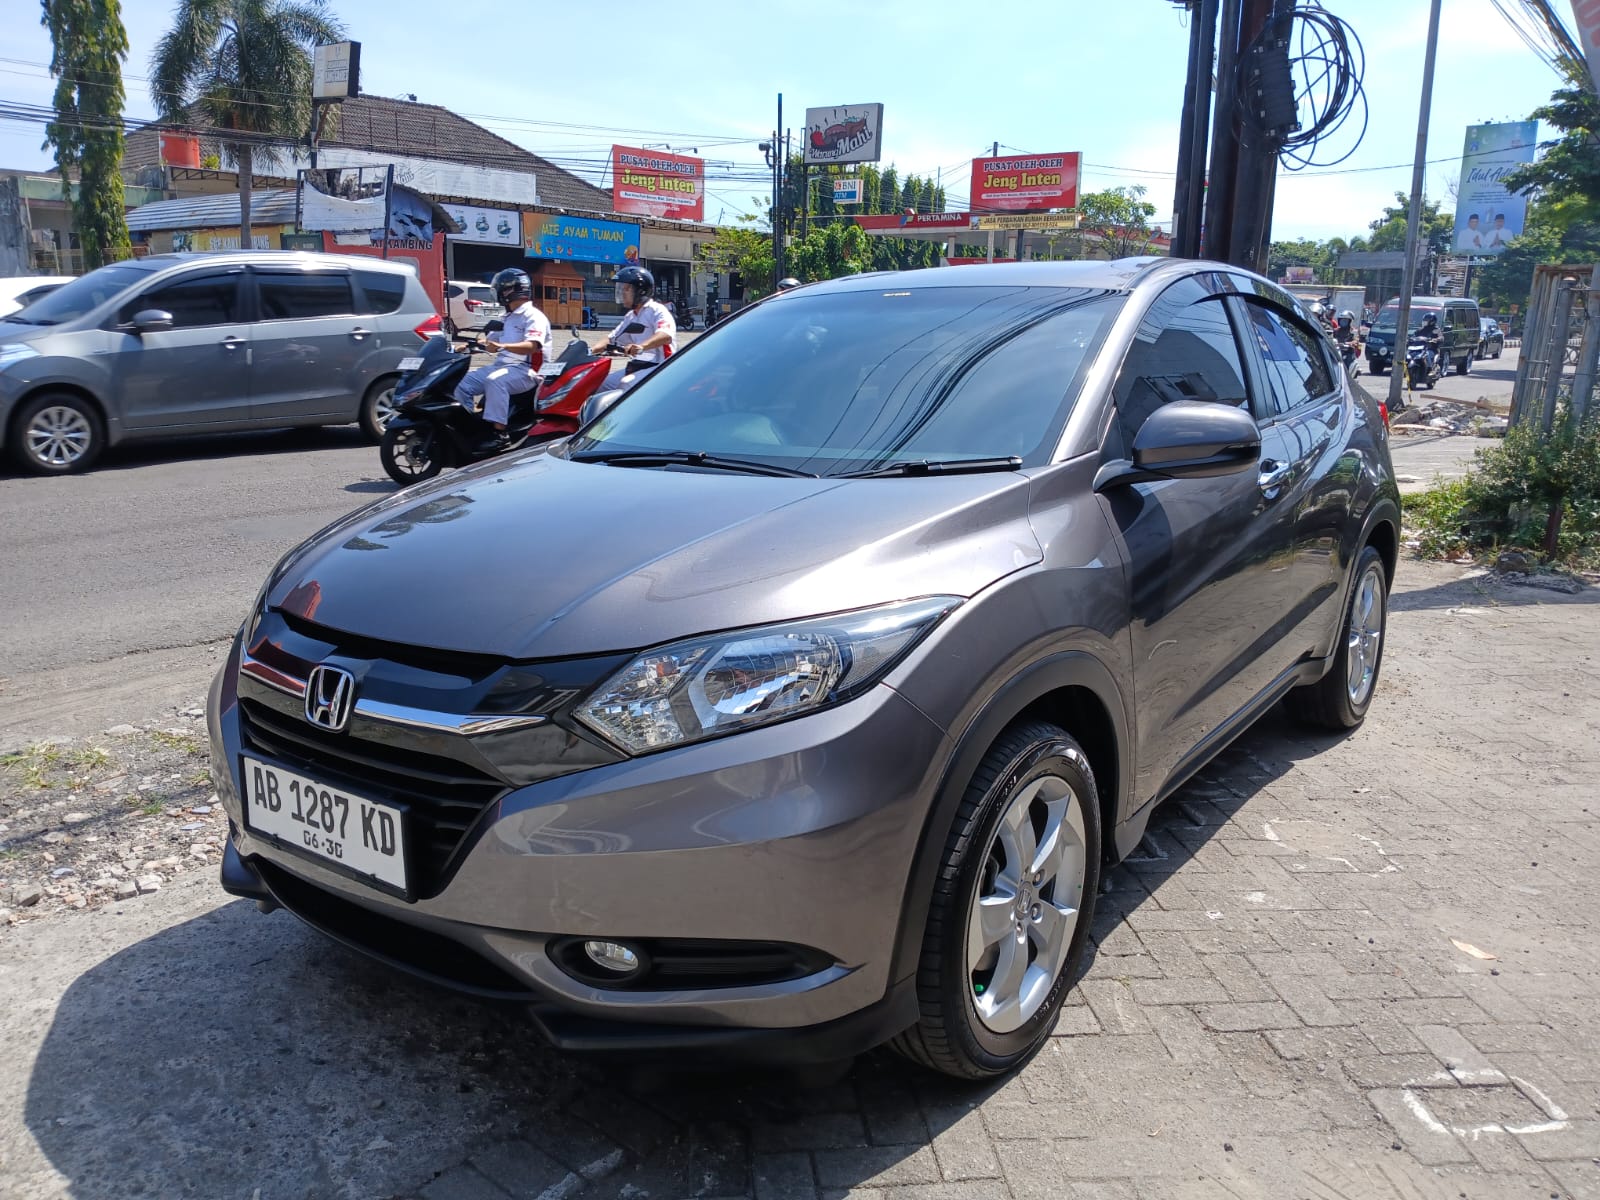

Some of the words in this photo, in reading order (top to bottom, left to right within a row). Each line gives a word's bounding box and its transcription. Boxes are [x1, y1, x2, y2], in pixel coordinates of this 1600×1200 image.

[836, 126, 872, 156] Mahi
[620, 154, 648, 168] PUSAT
[650, 159, 695, 174] OLEH-OLEH
[984, 161, 1013, 172] PUSAT
[1013, 158, 1063, 170] OLEH-OLEH
[621, 168, 656, 192] Jeng
[659, 172, 695, 194] Inten
[983, 174, 1018, 190] Jeng
[1021, 172, 1061, 186] Inten
[1466, 167, 1491, 183] Idul
[842, 181, 856, 190] BNI
[917, 213, 962, 222] PERTAMINA
[541, 223, 560, 236] MIE
[563, 226, 589, 239] AYAM
[591, 228, 624, 242] TUMAN
[387, 239, 433, 250] KAMBING
[254, 766, 282, 812] AB
[289, 780, 349, 839] 1287
[360, 804, 396, 857] KD
